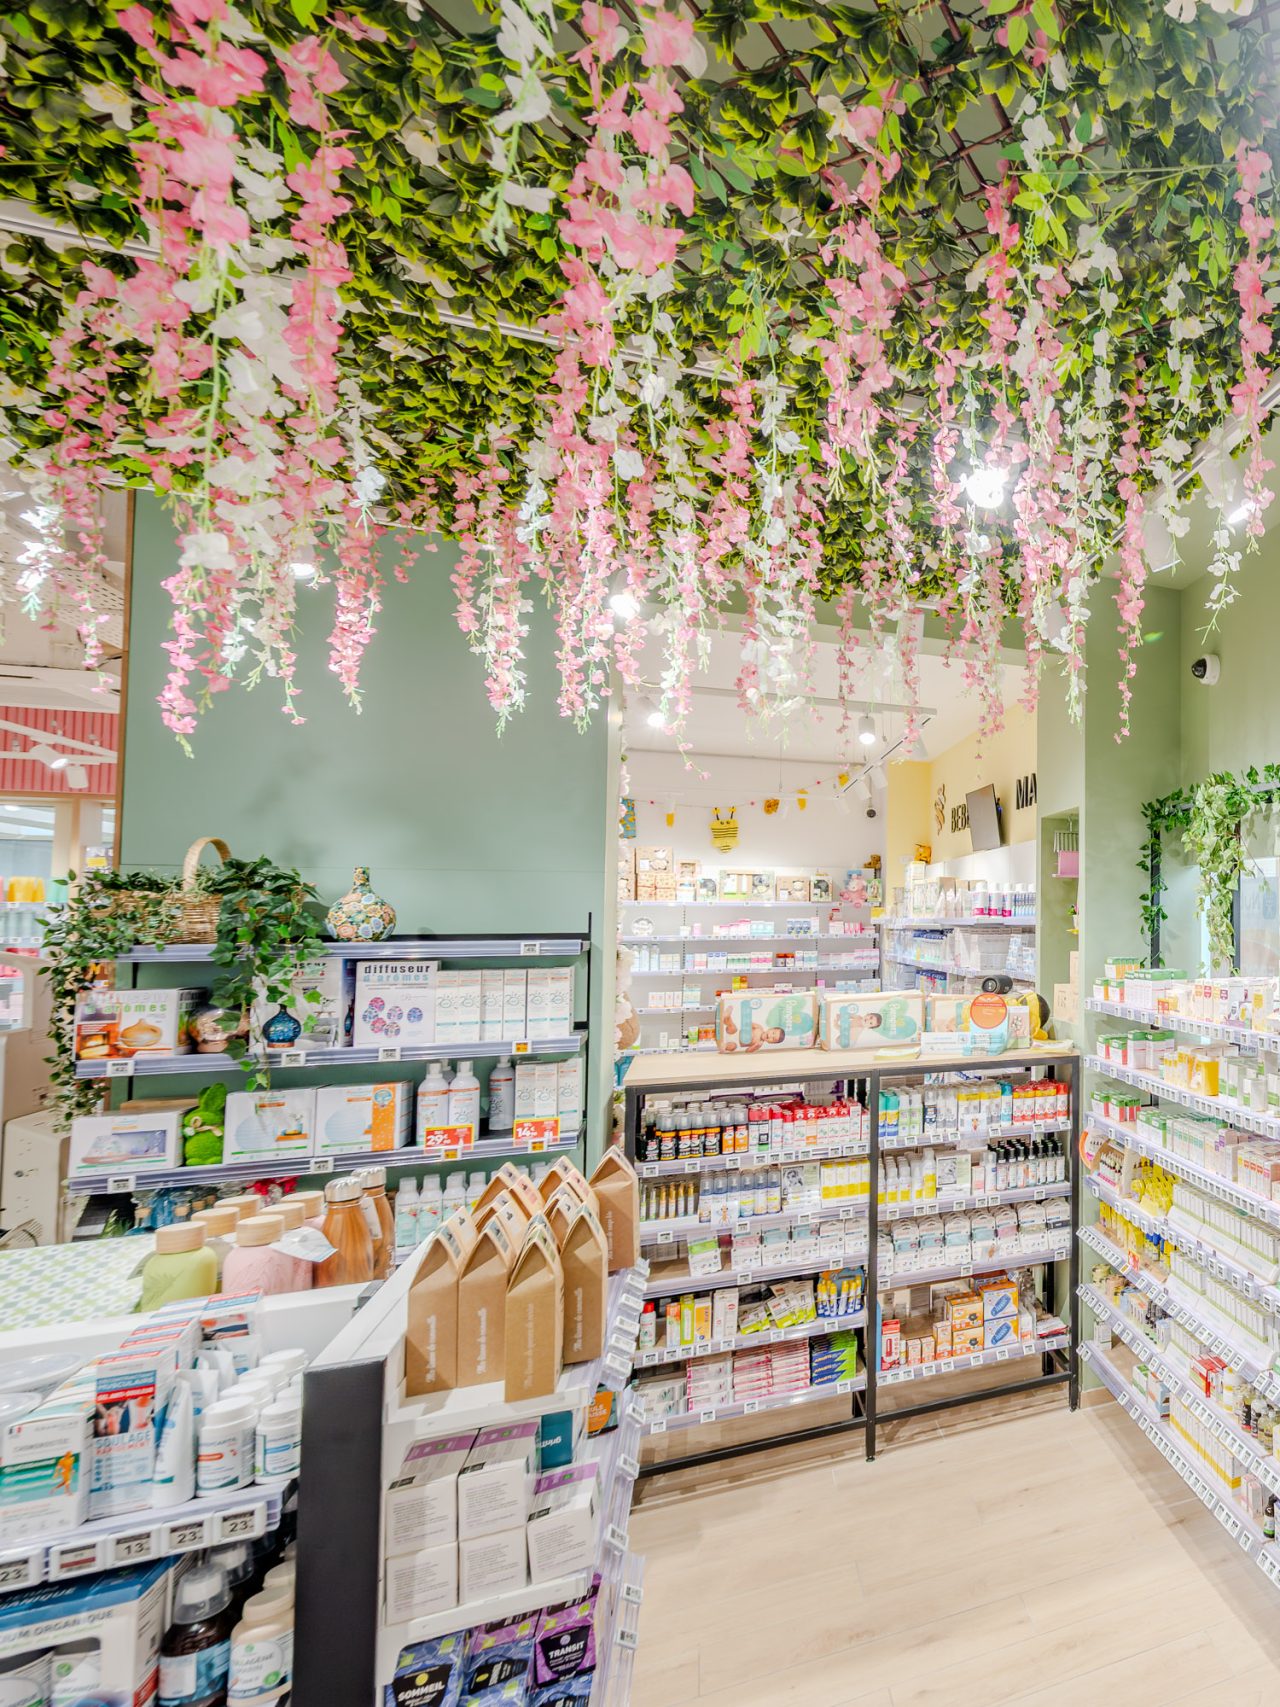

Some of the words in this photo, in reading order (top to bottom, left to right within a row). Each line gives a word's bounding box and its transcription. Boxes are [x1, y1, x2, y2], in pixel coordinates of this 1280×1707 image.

[1016, 772, 1038, 810] MA
[951, 803, 970, 833] BEB
[364, 964, 431, 975] diffuseur
[230, 1520, 249, 1533] 23
[178, 1532, 198, 1545] 23
[124, 1542, 144, 1555] 13
[548, 1640, 585, 1660] TRANSIT
[398, 1682, 445, 1703] SOMMEIL
